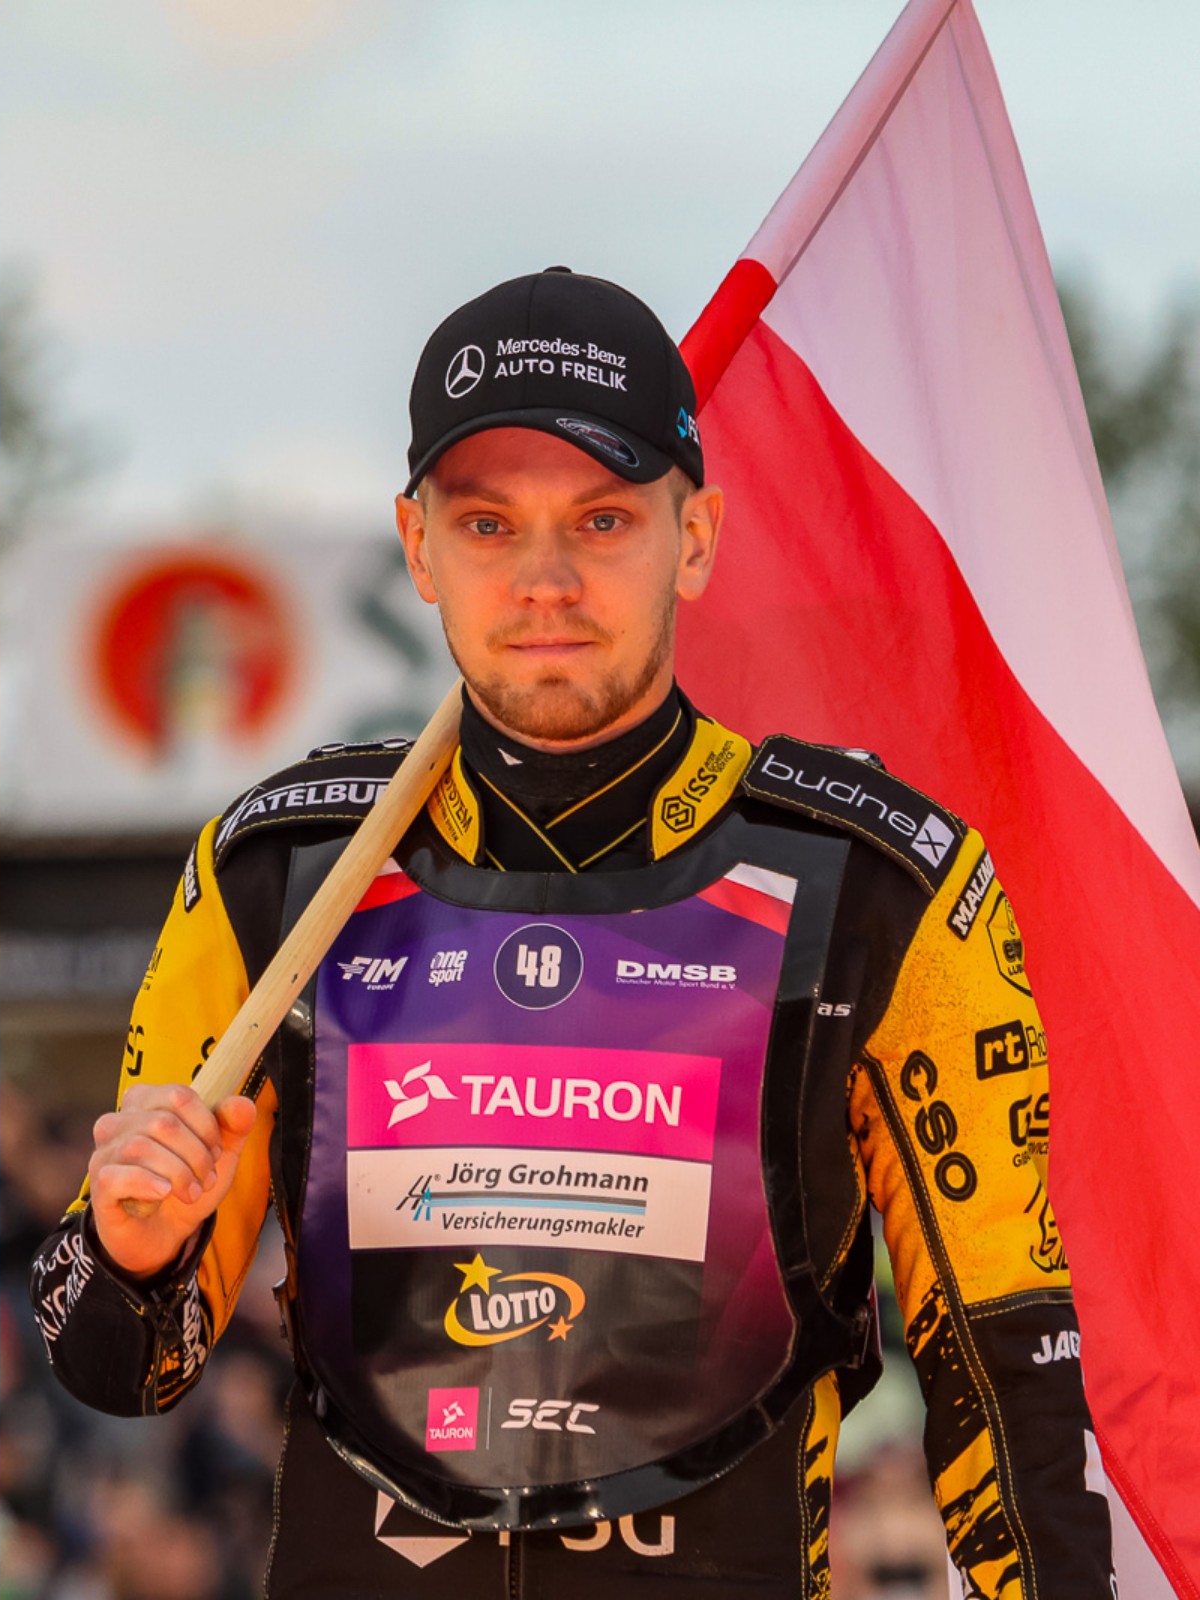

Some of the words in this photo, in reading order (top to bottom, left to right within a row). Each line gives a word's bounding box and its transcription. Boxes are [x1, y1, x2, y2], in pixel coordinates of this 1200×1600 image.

[496, 338, 626, 369] Mercedes-Benz
[495, 359, 554, 378] AUTO
[561, 362, 628, 391] FRELIK
[683, 767, 718, 803] ISS
[338, 956, 408, 983] FIM
[430, 950, 468, 969] one
[516, 945, 562, 988] 48
[617, 960, 737, 982] DMSB
[428, 968, 464, 987] sport
[701, 981, 719, 989] Bund
[984, 1031, 1024, 1071] rt
[461, 1075, 683, 1127] TAURON
[901, 1050, 978, 1202] CSO
[447, 1162, 502, 1191] Jörg
[508, 1164, 650, 1193] Grohmann
[441, 1212, 646, 1239] Versicherungsmakler
[470, 1286, 557, 1331] LOTTO
[500, 1399, 600, 1435] SEC
[429, 1427, 473, 1440] TAURON
